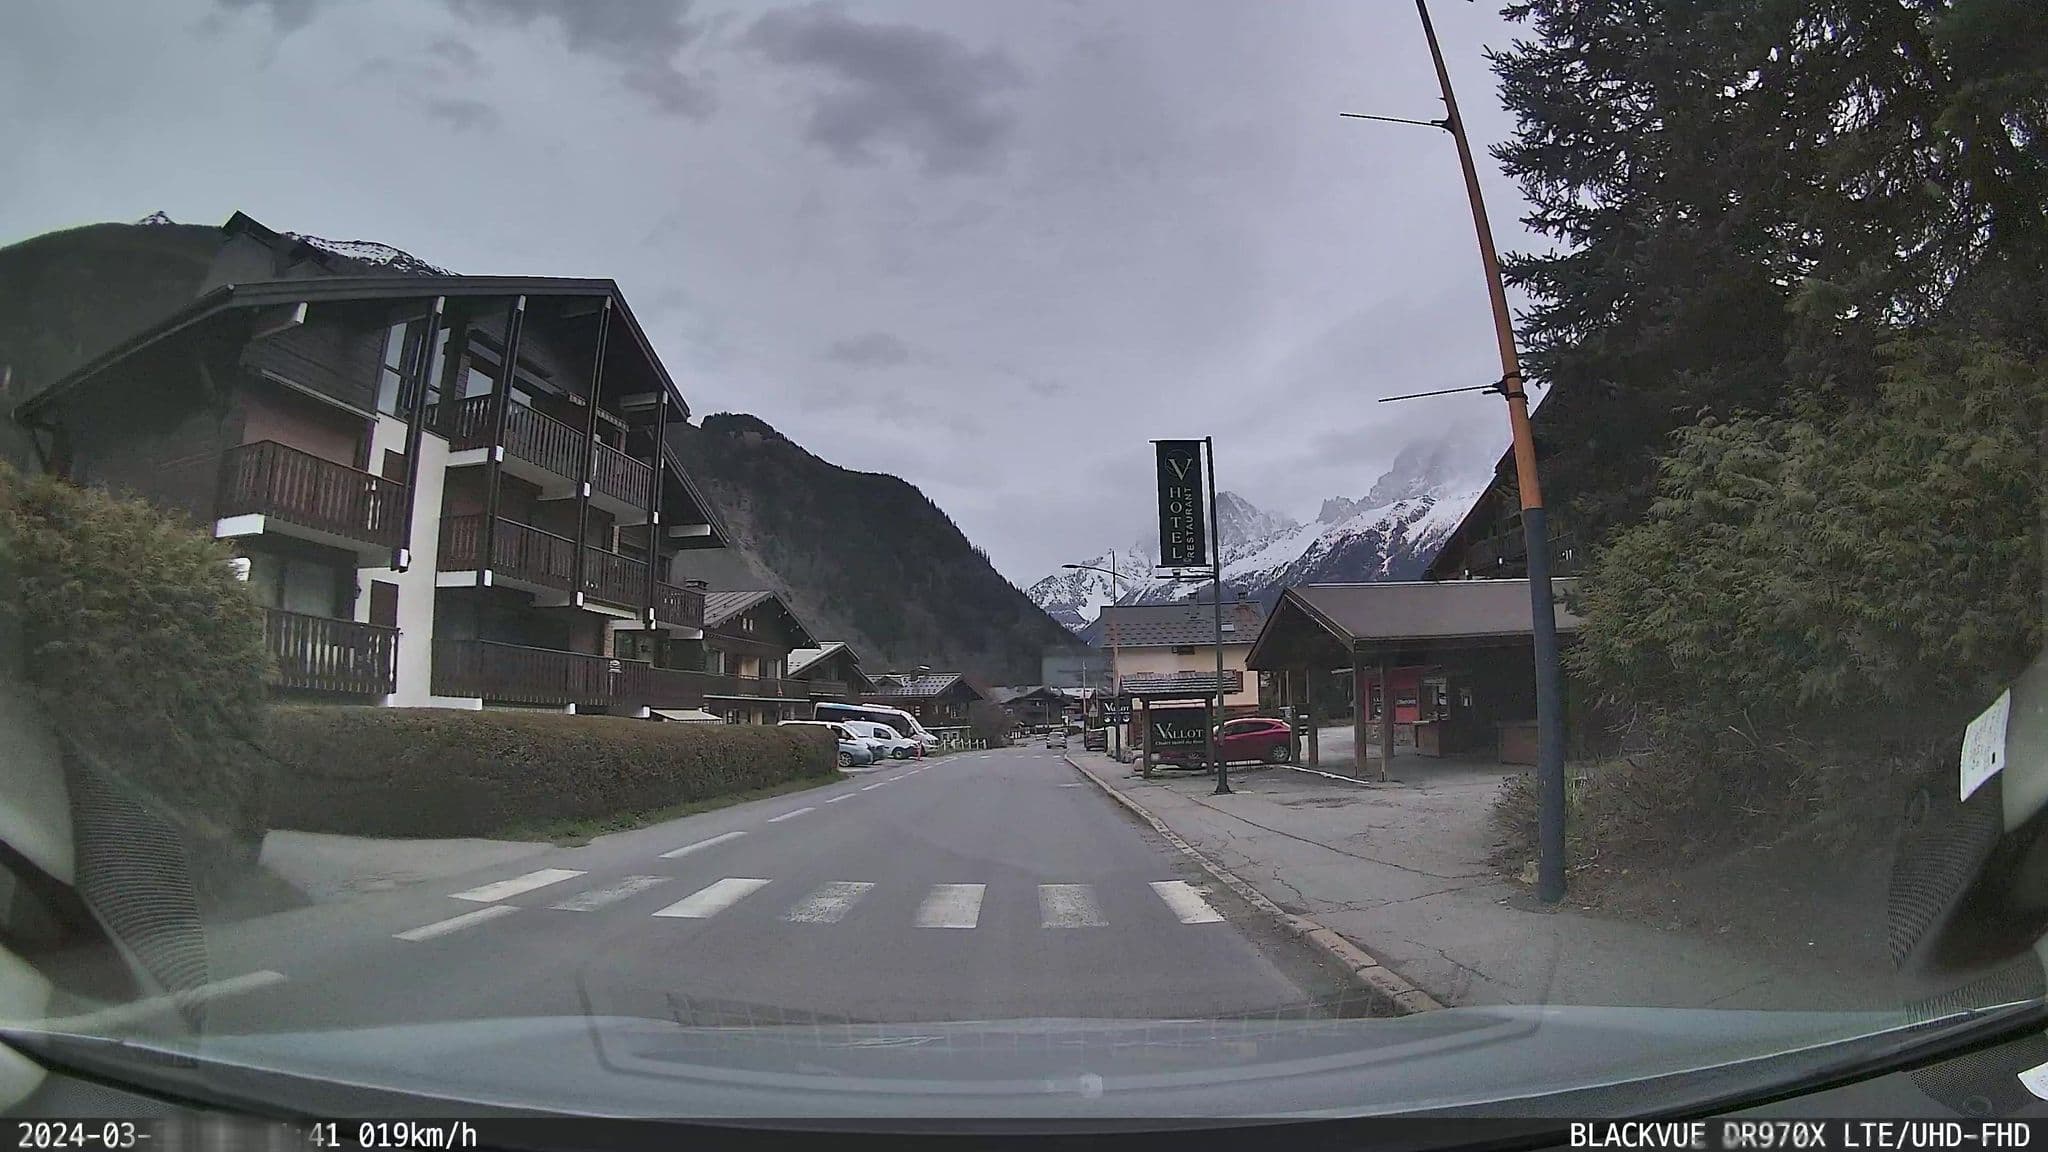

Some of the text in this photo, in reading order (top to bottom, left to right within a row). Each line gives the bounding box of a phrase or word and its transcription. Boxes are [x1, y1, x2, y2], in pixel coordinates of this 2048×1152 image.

[1168, 458, 1193, 481] V
[1169, 486, 1182, 559] HOTEL
[1184, 487, 1195, 559] RESTAURANT
[1155, 722, 1204, 739] VALLOT
